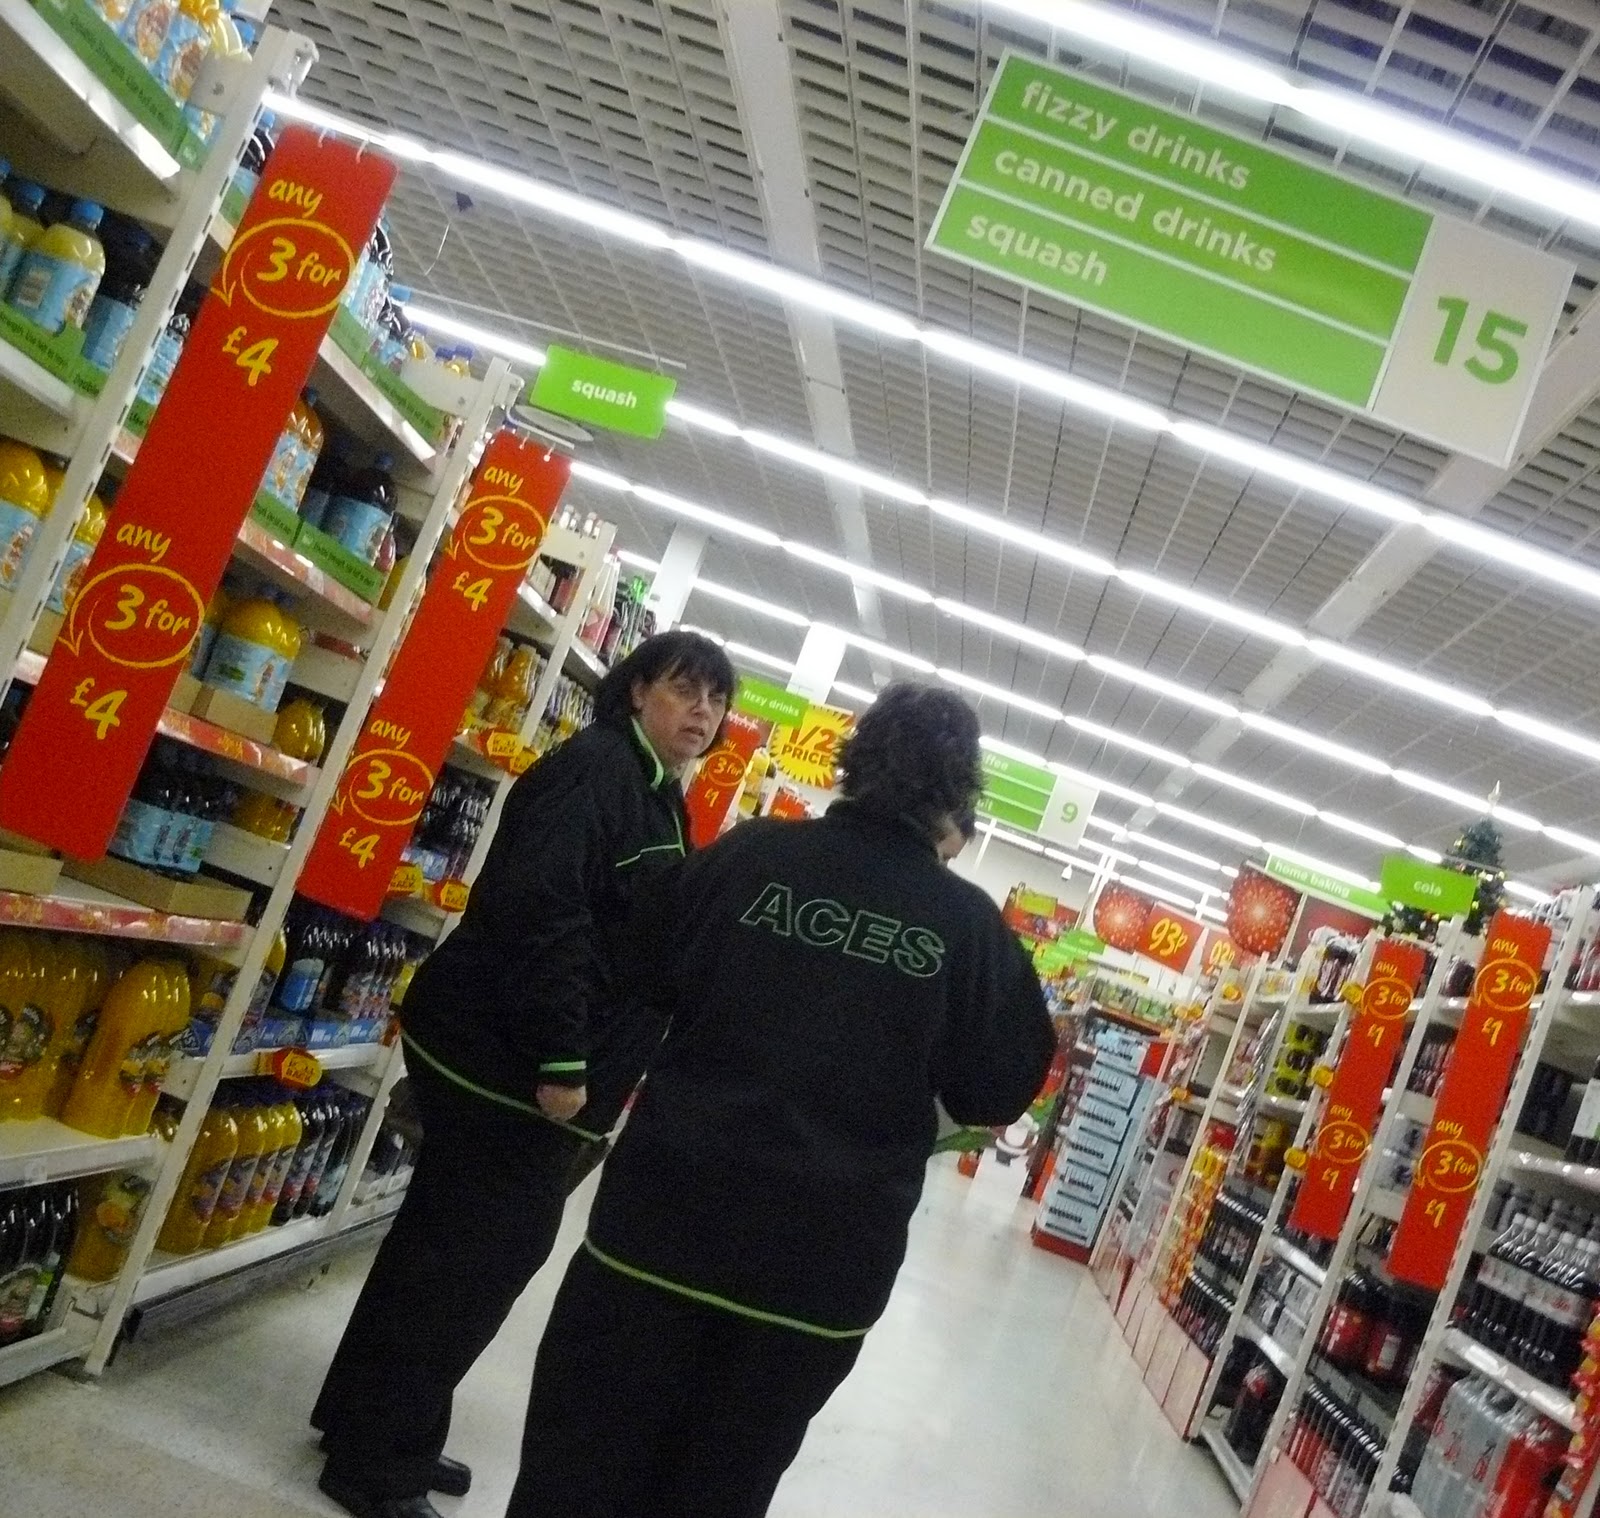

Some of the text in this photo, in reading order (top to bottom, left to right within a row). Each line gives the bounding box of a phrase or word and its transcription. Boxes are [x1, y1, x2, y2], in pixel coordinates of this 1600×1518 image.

[1021, 79, 1251, 191] fizzy drinks
[268, 179, 323, 218] any
[994, 148, 1278, 272] canned drinks
[257, 236, 342, 287] 3 for
[965, 213, 1109, 287] squash
[222, 326, 279, 387] £4
[1431, 295, 1530, 386] 15
[571, 379, 637, 408] squash
[484, 466, 524, 496] any
[116, 523, 171, 563] any
[469, 506, 537, 551] 3 for
[104, 583, 191, 636] 3 for
[452, 571, 493, 612] £4
[70, 677, 128, 740] £4
[743, 690, 800, 717] fizzy drinks
[370, 718, 411, 749] any
[714, 756, 742, 777] 3 for
[781, 743, 830, 768] PRICE
[356, 759, 424, 805] 3 for
[1060, 801, 1079, 824] 9
[339, 827, 380, 868] £4
[1275, 859, 1351, 899] home baking
[1413, 879, 1442, 898] cola
[738, 881, 946, 978] ACES
[1148, 917, 1188, 957] 93p
[1491, 938, 1519, 958] any
[1375, 960, 1398, 978] any
[1490, 969, 1532, 995] 3 for
[1374, 985, 1410, 1007] 3 for
[1330, 1103, 1353, 1121] any
[1435, 1119, 1464, 1138] any
[1329, 1129, 1364, 1151] 3 for
[1433, 1151, 1476, 1175] 3 for
